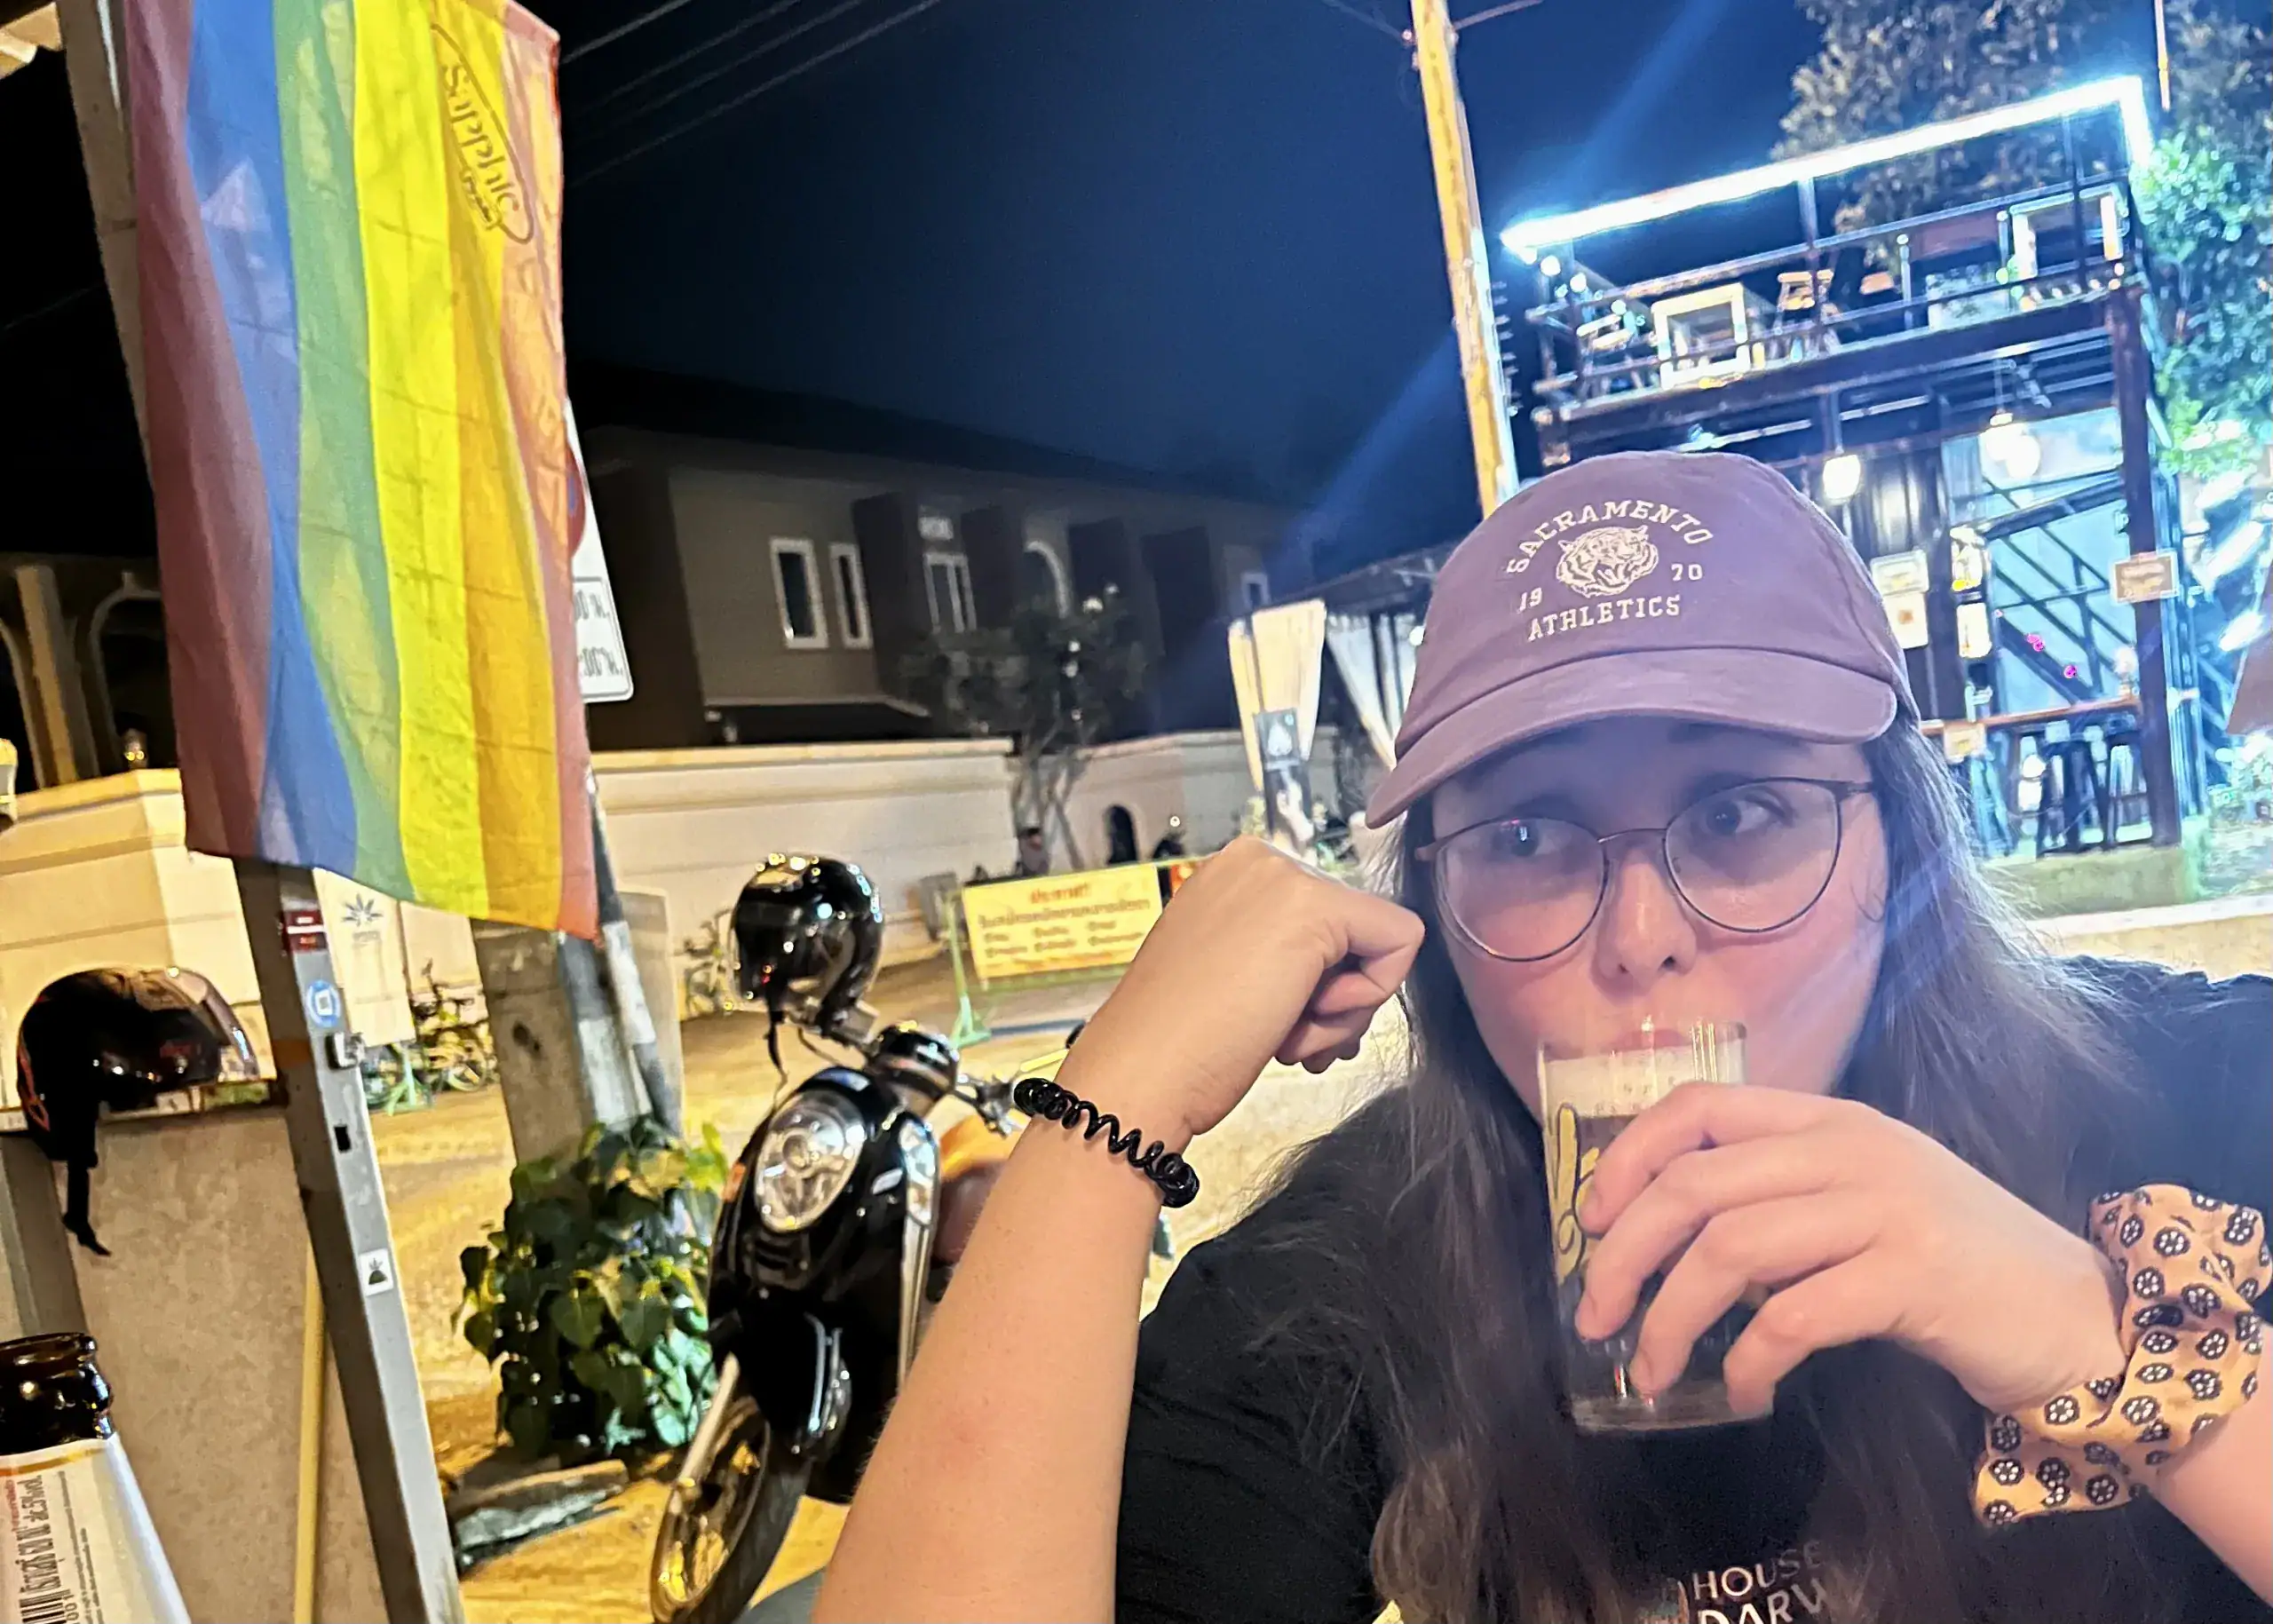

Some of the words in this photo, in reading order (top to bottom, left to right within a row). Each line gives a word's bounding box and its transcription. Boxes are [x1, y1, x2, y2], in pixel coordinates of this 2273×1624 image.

[1506, 499, 1714, 574] SACRAMENTO
[1517, 587, 1543, 614] 19
[1670, 563, 1703, 582] 70
[1527, 594, 1681, 642] ATHLETICS
[1692, 1540, 1823, 1600] HOUSE
